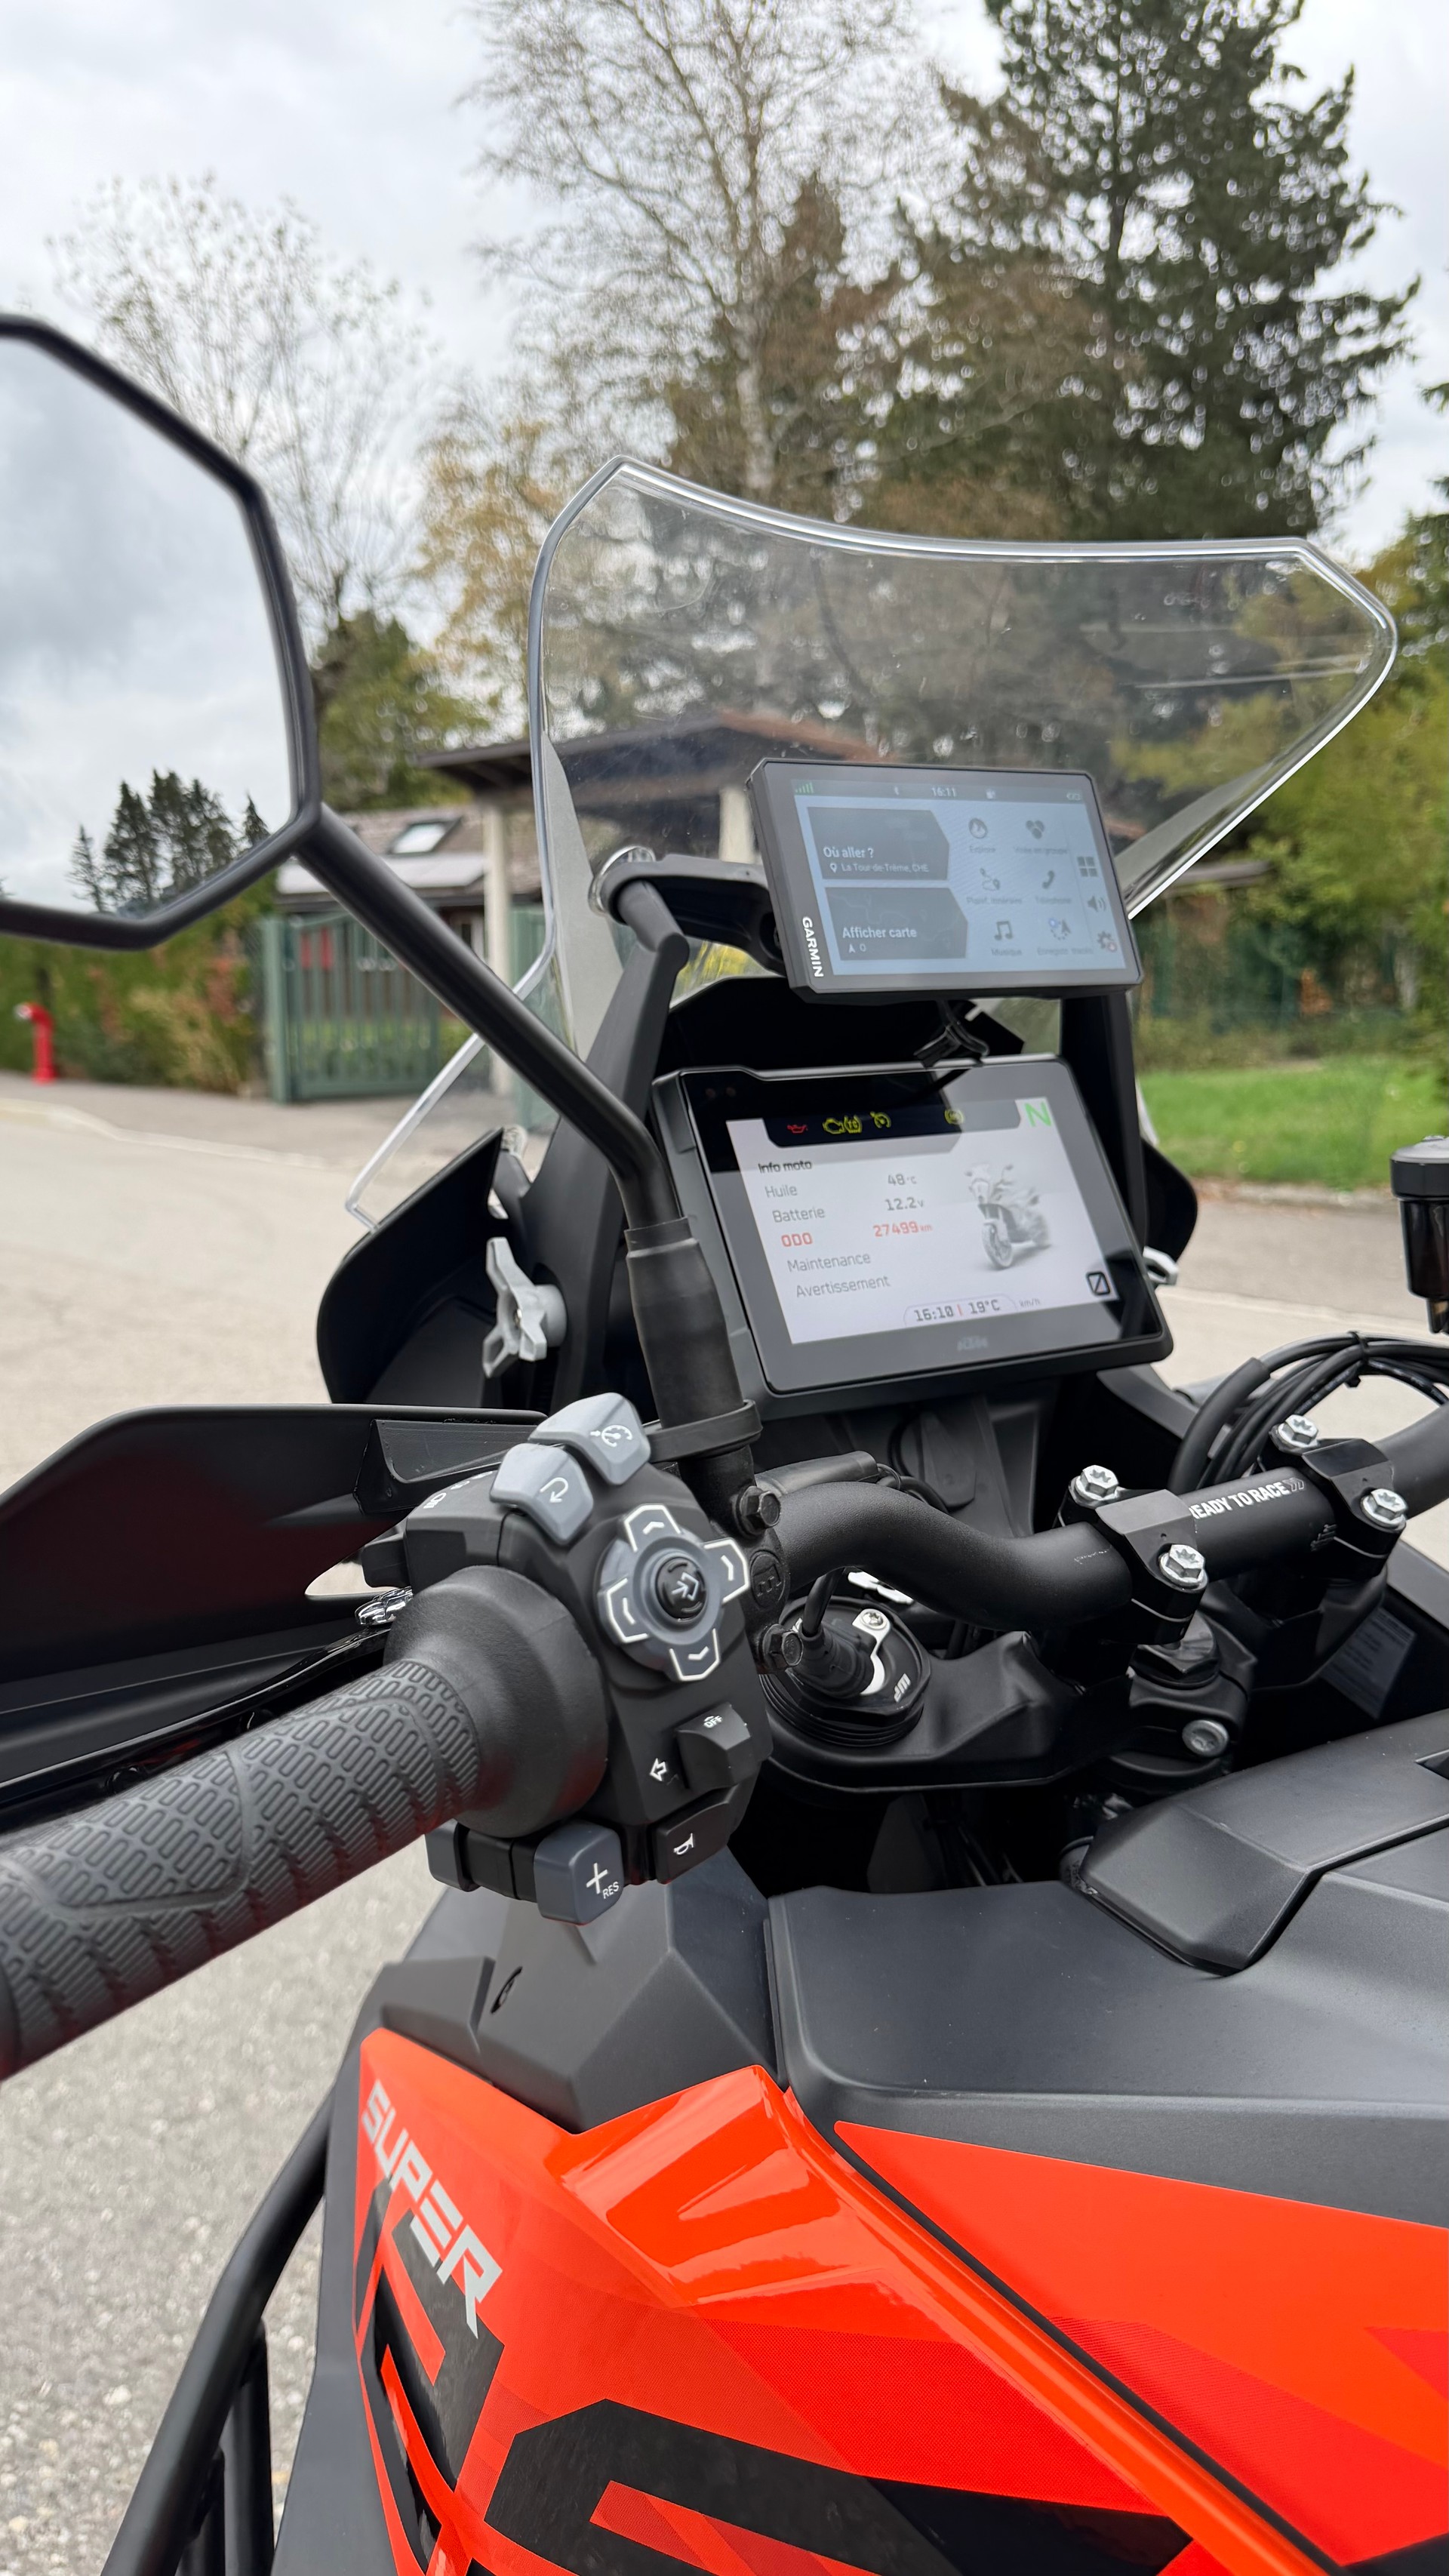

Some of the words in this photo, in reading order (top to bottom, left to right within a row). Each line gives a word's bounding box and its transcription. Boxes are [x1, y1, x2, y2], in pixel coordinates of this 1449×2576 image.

[932, 787, 957, 797] 16:11
[823, 846, 839, 858] Où
[842, 848, 866, 858] aller
[867, 848, 875, 858] ?
[841, 863, 852, 872] La
[842, 927, 886, 938] Afficher
[889, 928, 917, 938] carte
[802, 916, 824, 977] GARMIN
[1024, 1102, 1051, 1128] N
[758, 1162, 781, 1174] Info
[783, 1160, 813, 1171] moto
[764, 1184, 798, 1199] Huile
[772, 1207, 826, 1223] Batterie
[787, 1253, 871, 1273] Maintenance
[796, 1276, 891, 1297] Avertissement
[914, 1305, 955, 1322] 16:10
[968, 1299, 1001, 1315] 19°C
[1228, 1492, 1254, 1508] TO
[1247, 1482, 1292, 1503] RACE
[704, 1716, 723, 1728] OFF
[602, 1881, 620, 1900] RES
[361, 2079, 503, 2339] SUPER
